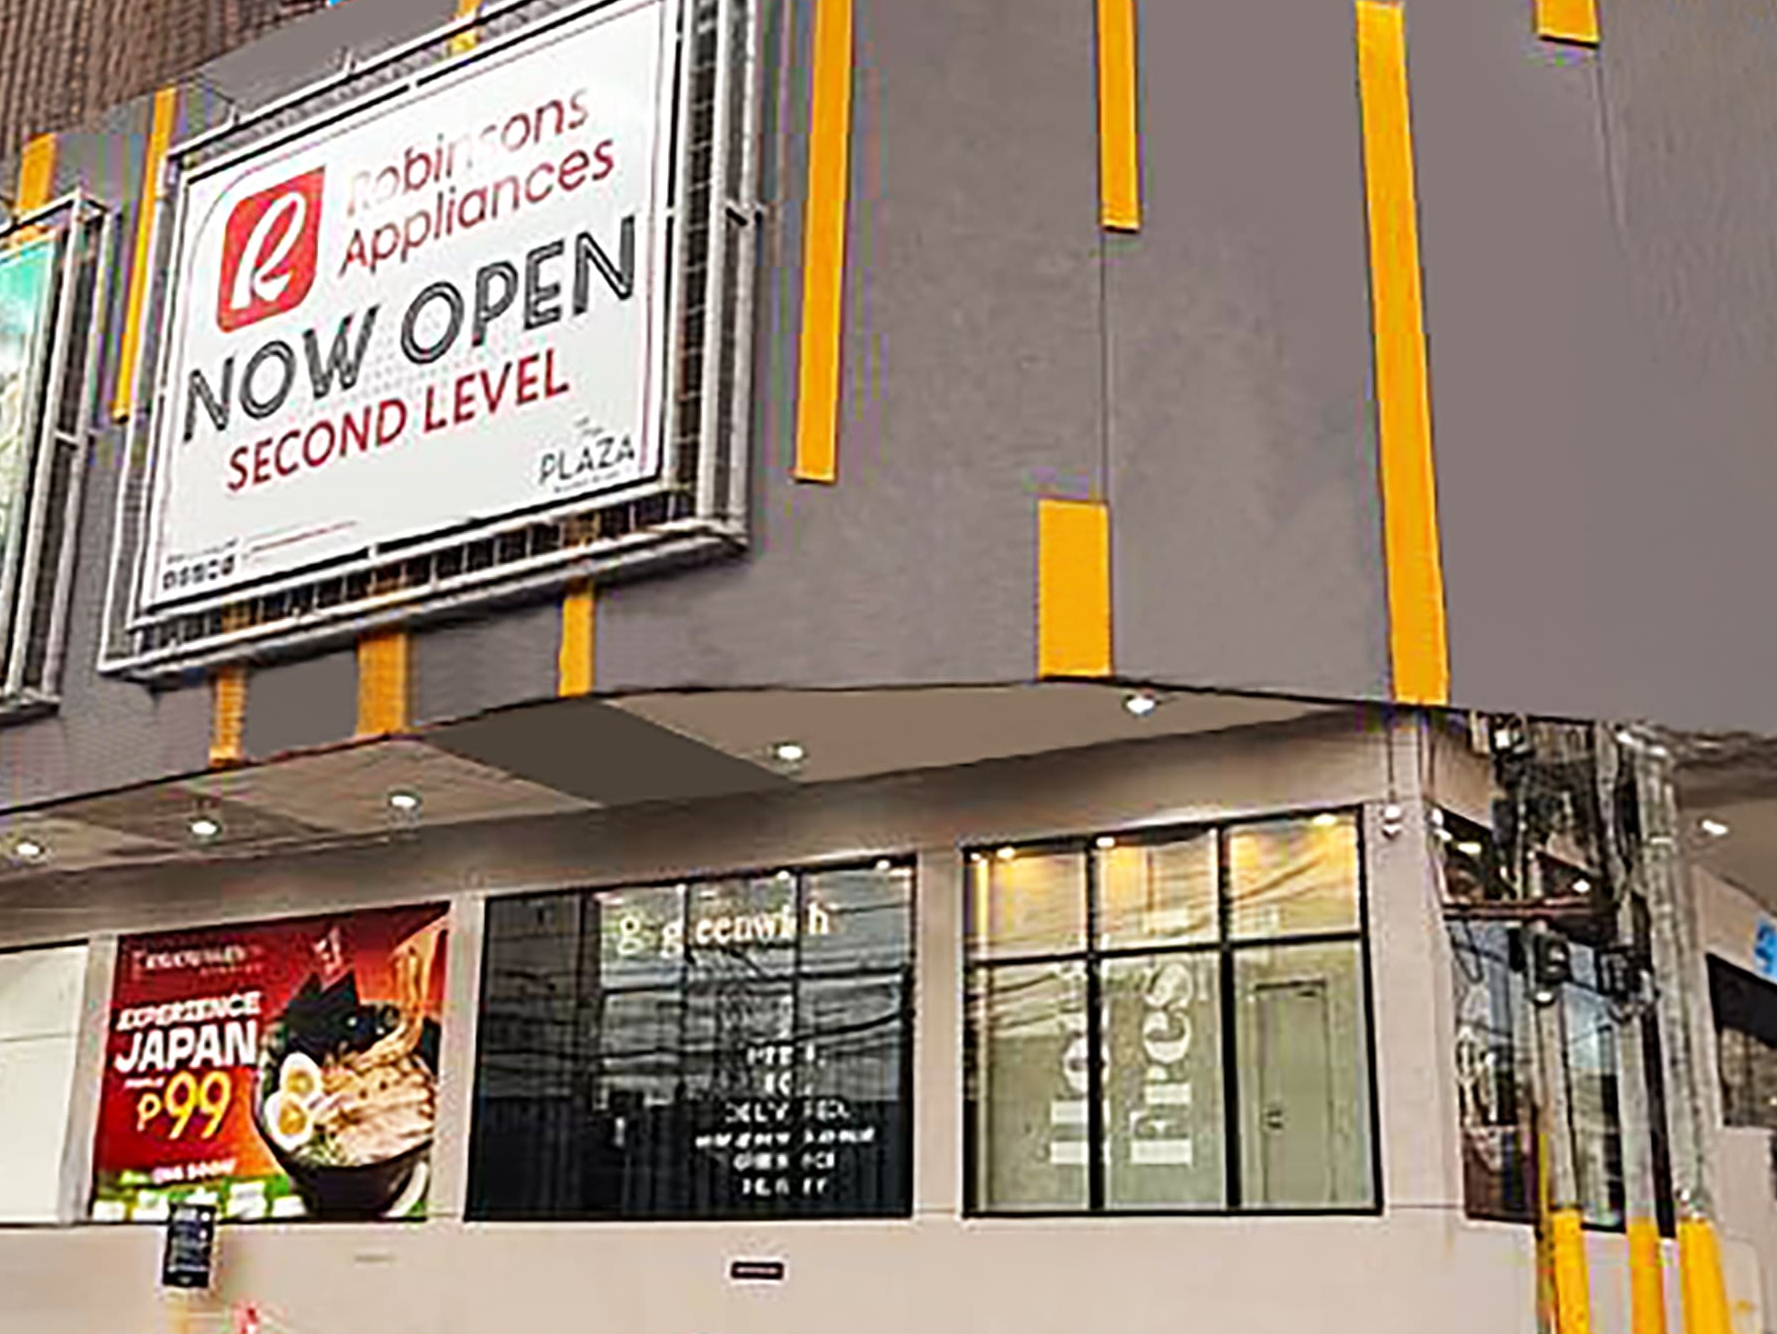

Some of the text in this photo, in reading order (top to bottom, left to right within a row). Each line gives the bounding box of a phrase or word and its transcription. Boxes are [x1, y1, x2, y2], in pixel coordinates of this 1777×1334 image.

[339, 140, 613, 278] Appliances
[183, 214, 635, 442] NOW OPEN
[227, 348, 570, 492] SECOND LEVEL
[538, 433, 635, 485] PLAZA
[660, 901, 830, 958] geenwih
[115, 1019, 258, 1073] JAPAN
